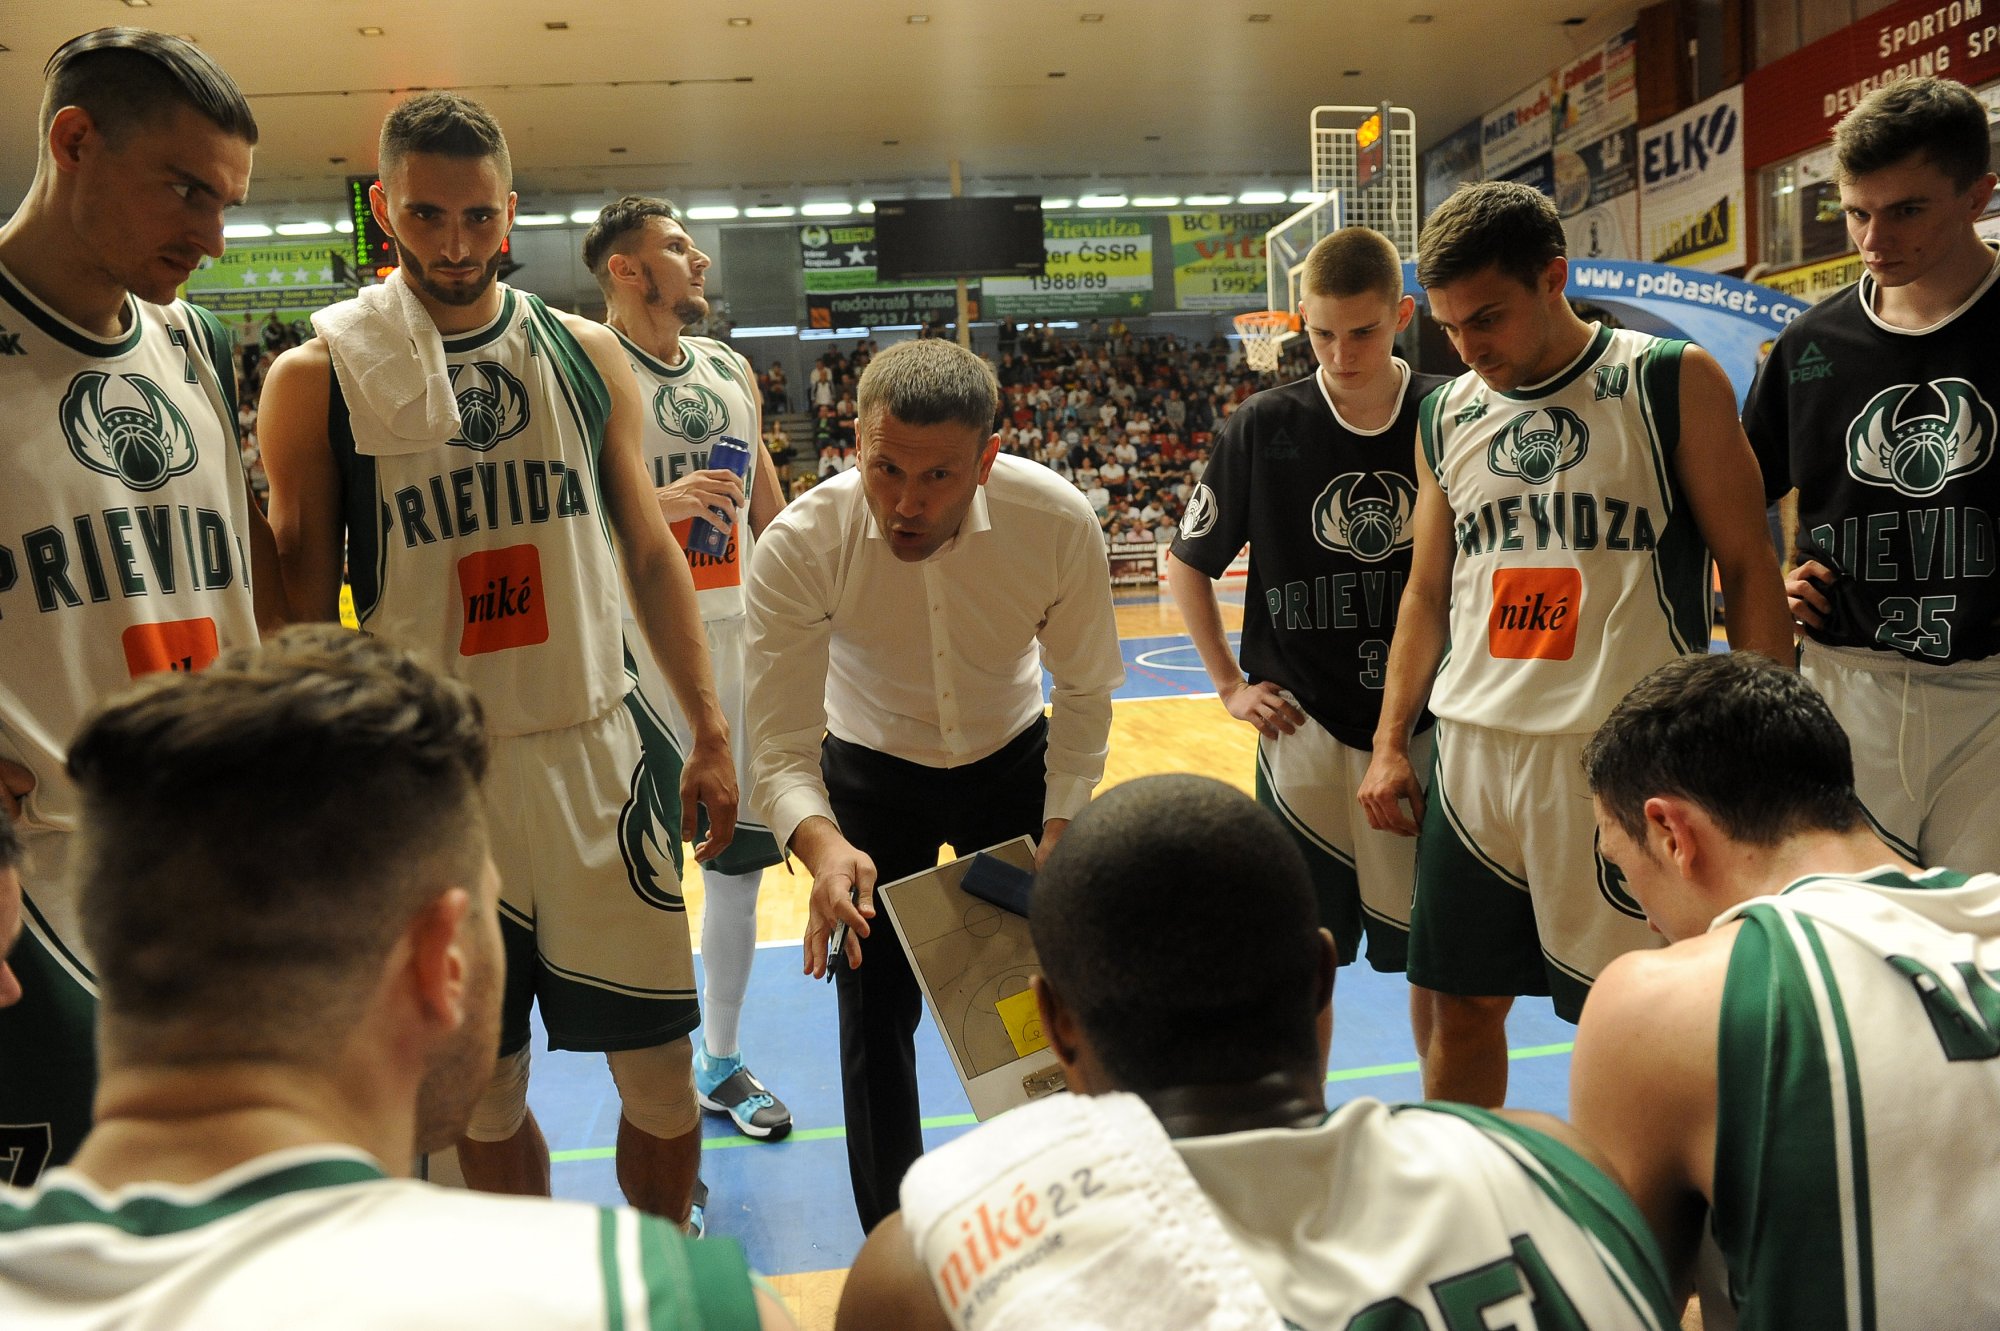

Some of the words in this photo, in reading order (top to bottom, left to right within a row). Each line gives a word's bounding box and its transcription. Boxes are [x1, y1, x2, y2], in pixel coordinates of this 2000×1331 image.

[1878, 0, 1982, 59] ŠPORTOM
[1967, 25, 2000, 59] SP
[1644, 103, 1737, 185] ELKO
[1078, 241, 1138, 263] ČSSR
[1030, 272, 1107, 291] 1988/89
[1594, 362, 1629, 401] 10
[1789, 361, 1833, 385] PEAK
[467, 576, 531, 624] niké
[1498, 592, 1568, 631] niké
[1875, 594, 1957, 658] 25
[937, 1182, 1049, 1312] niké
